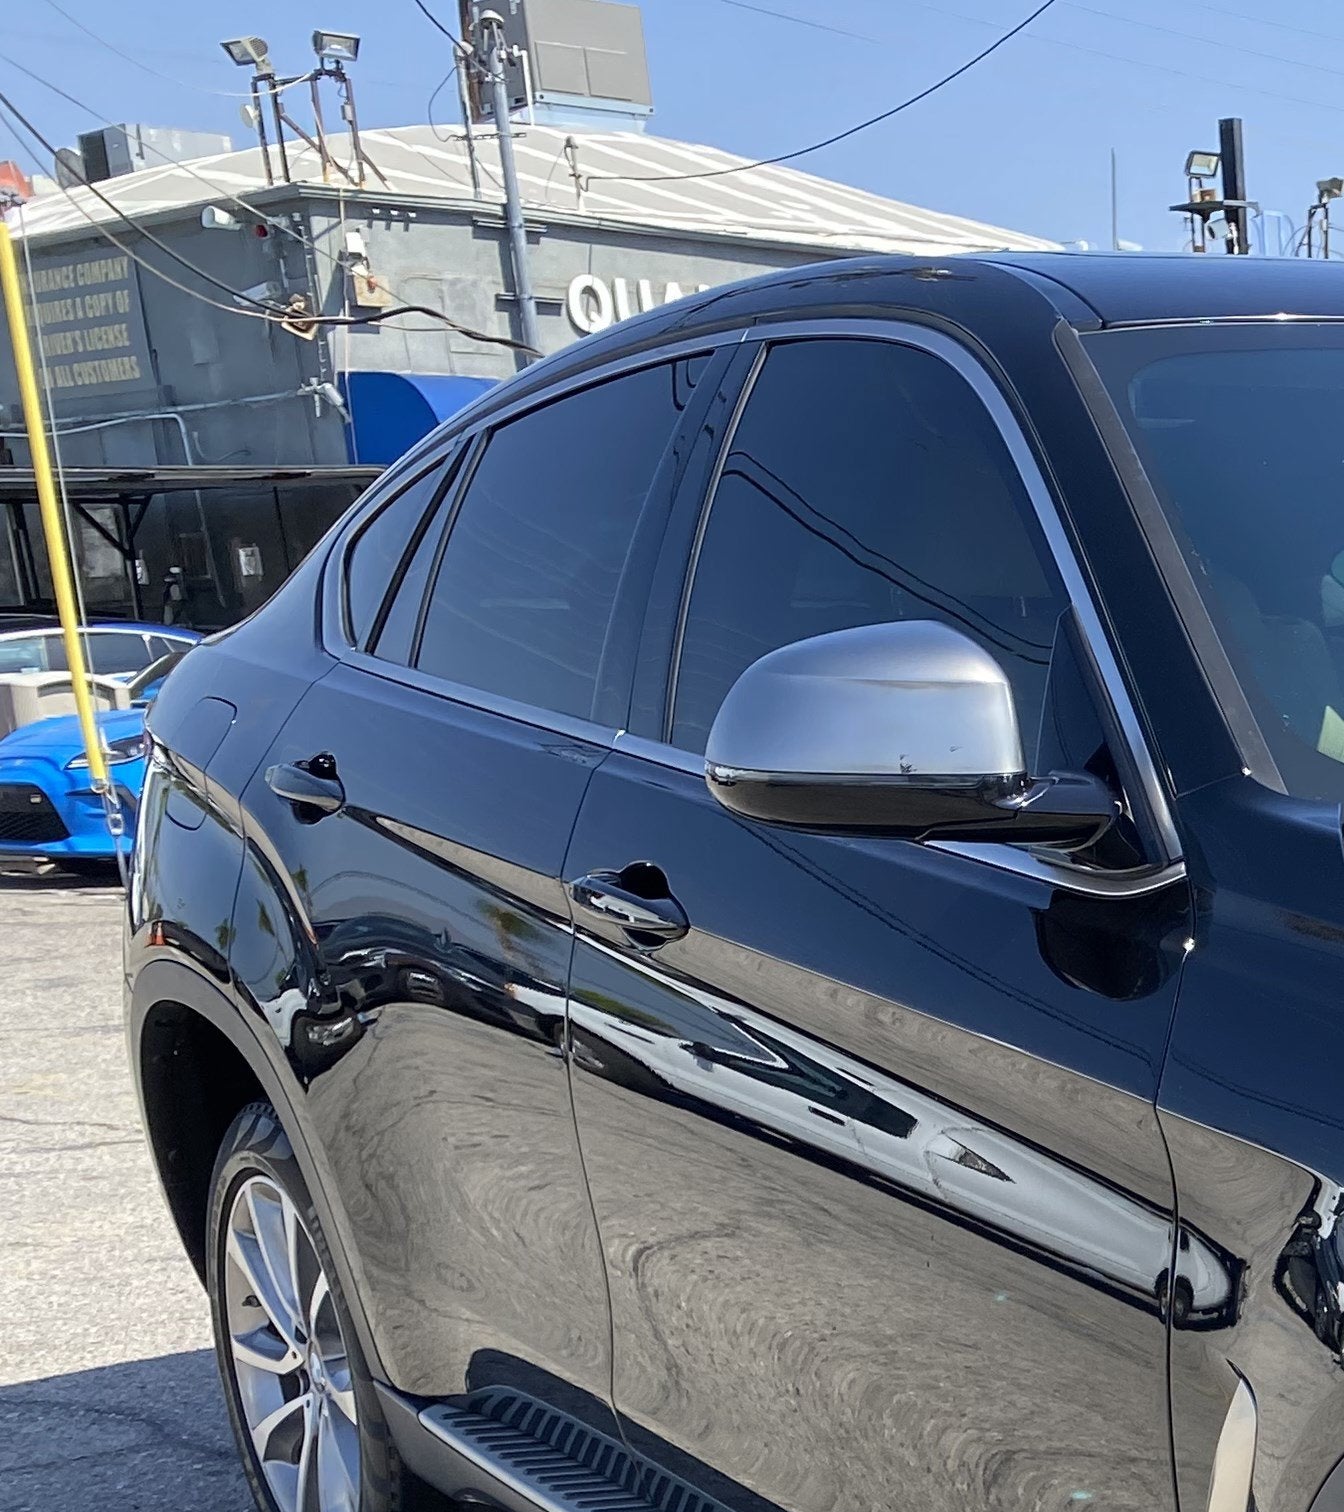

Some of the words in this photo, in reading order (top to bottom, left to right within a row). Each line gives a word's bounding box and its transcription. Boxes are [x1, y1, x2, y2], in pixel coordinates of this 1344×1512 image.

[77, 256, 129, 286] COMPANY
[85, 293, 113, 318] COPY
[116, 290, 130, 313] OF
[84, 323, 130, 351] LICENSE
[73, 356, 141, 386] CUSTOMERS
